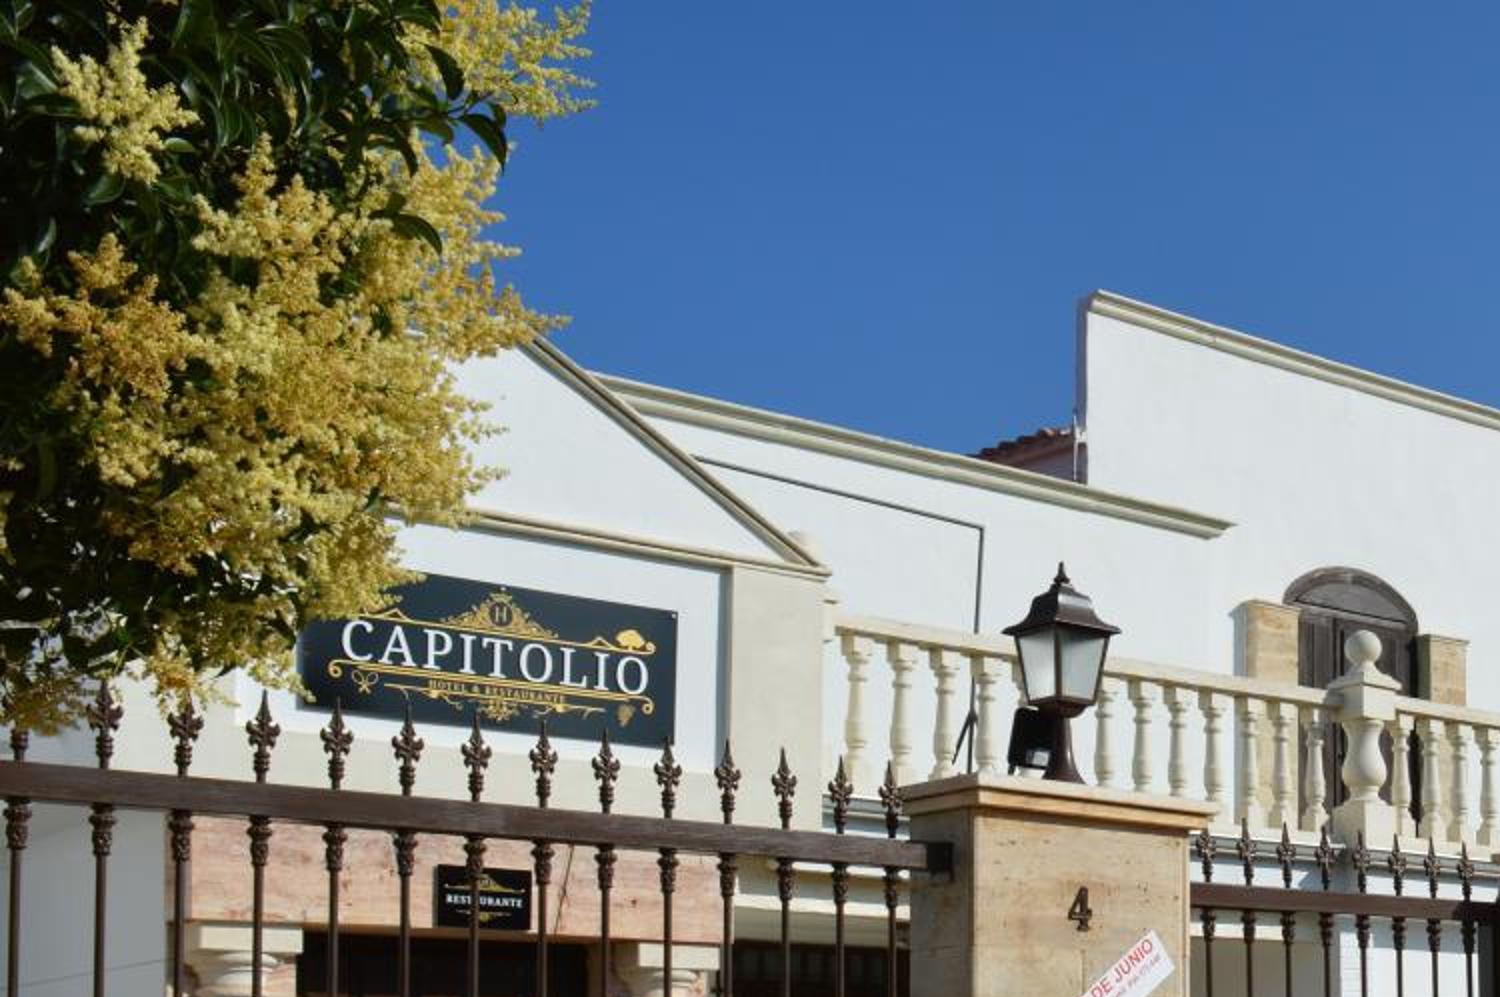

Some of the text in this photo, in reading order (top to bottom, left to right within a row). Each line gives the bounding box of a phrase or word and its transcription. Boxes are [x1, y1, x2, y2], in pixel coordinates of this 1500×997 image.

[341, 620, 650, 695] CAPITOLIO
[428, 679, 466, 695] HOTEL
[446, 893, 524, 909] RESTURANTE
[1067, 886, 1093, 932] 4
[1114, 937, 1154, 985] JUNIO
